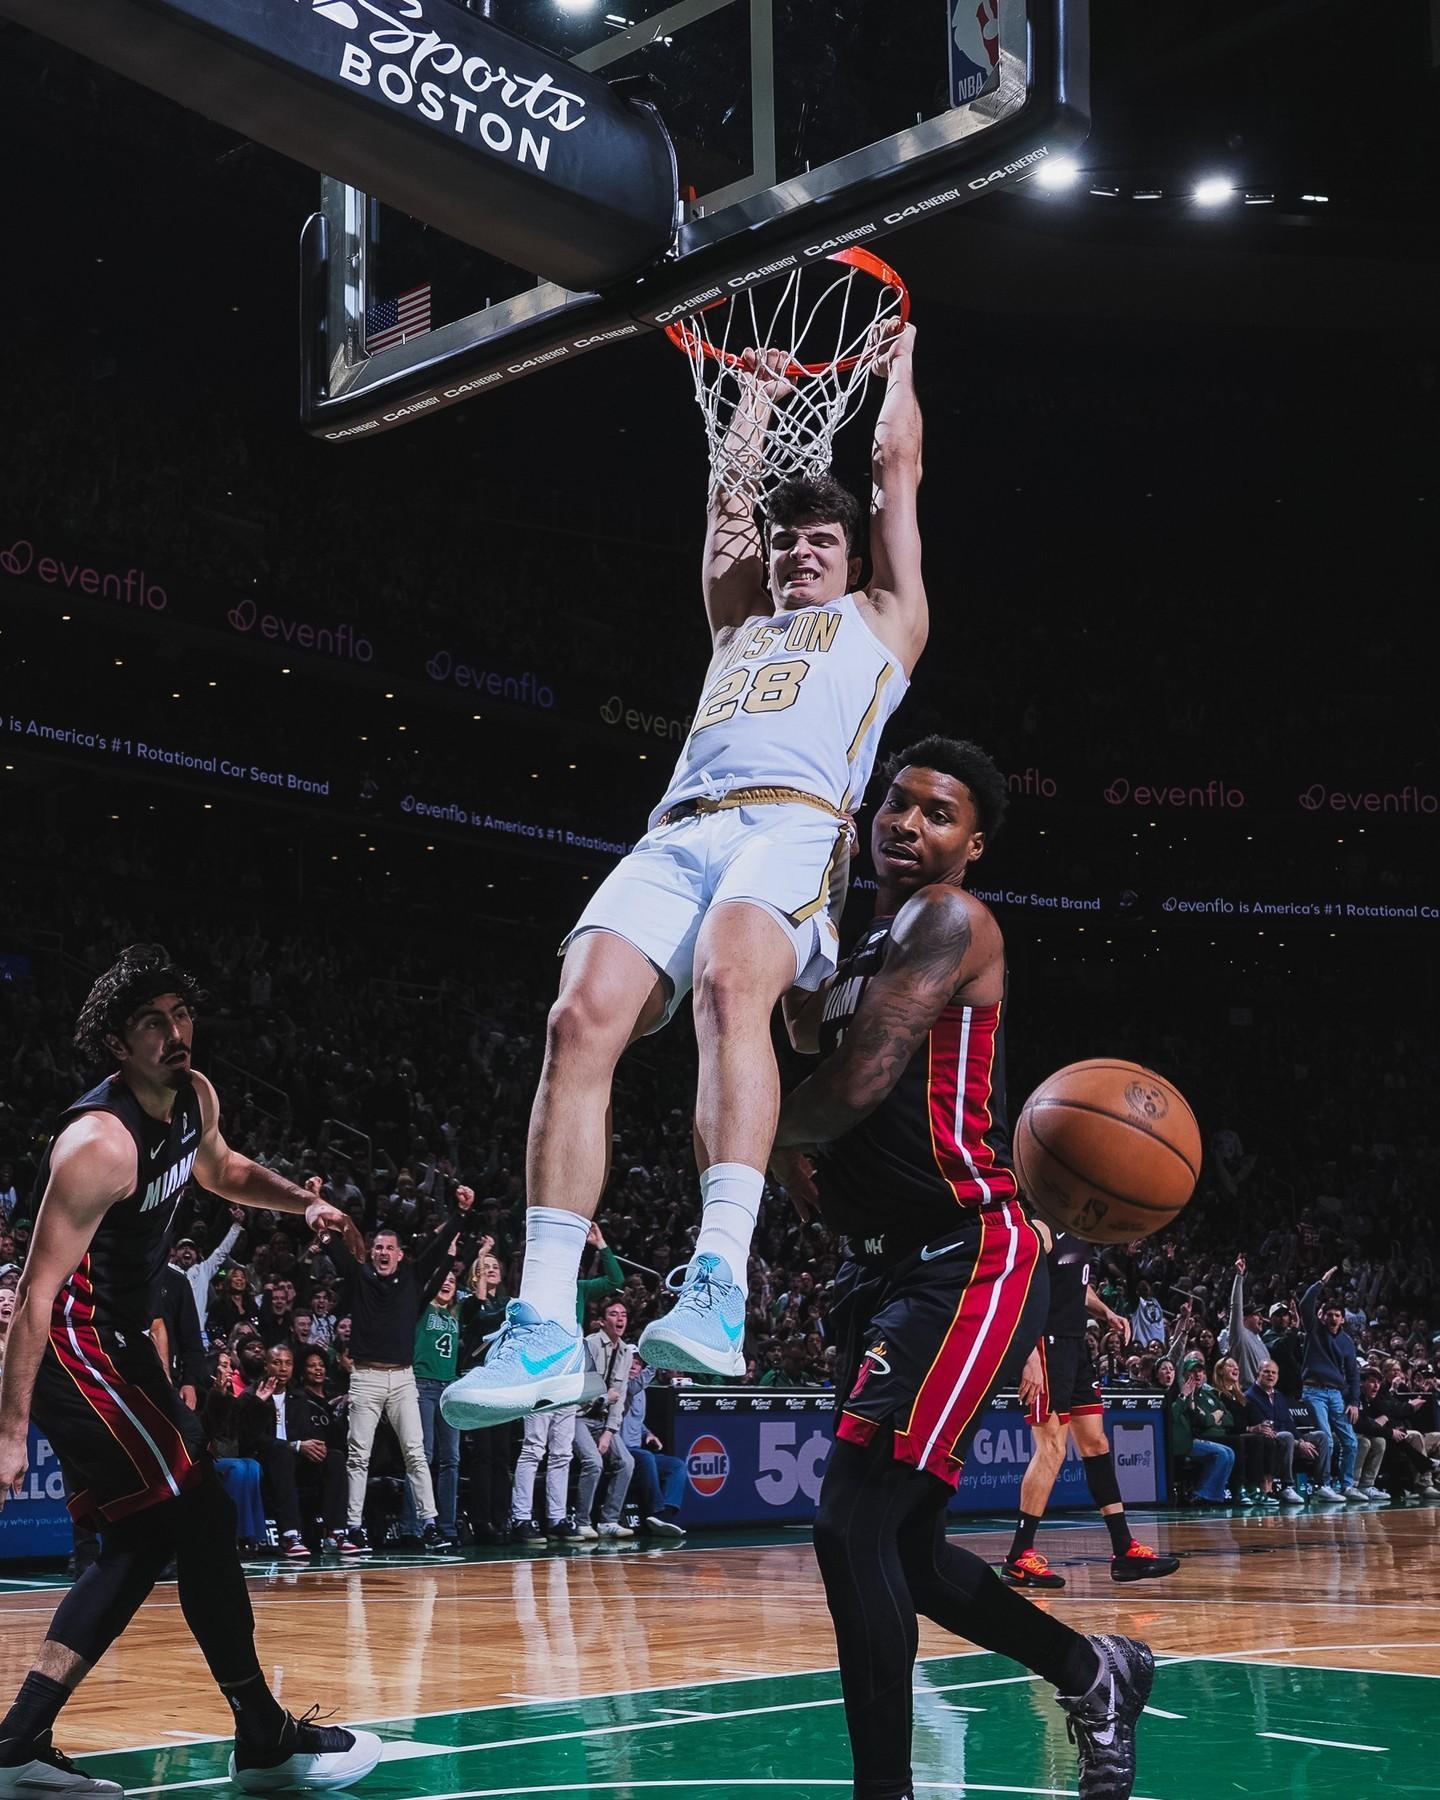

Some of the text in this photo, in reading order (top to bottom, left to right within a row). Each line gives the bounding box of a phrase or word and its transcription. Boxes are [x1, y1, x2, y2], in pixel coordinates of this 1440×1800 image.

[356, 0, 586, 131] Sports
[958, 72, 983, 102] NBA
[339, 42, 550, 171] BOSTON
[968, 146, 1049, 191] C4 ENERGY
[883, 188, 960, 225] C4 ENERGY
[803, 223, 877, 257] C4 ENERGY
[727, 255, 798, 287] C4 ENERGY
[655, 287, 722, 323] C4 ENERGY
[574, 324, 638, 348] C4 ENERGY
[507, 347, 569, 374] C4 ENERGY
[444, 372, 503, 399] C4 ENERGY
[383, 396, 440, 422] C4 ENERGY
[325, 421, 380, 440] C4 ENERGY
[38, 558, 167, 610] evenflo
[261, 614, 374, 661] evenflo
[454, 664, 554, 708] evenflo
[690, 659, 810, 738] 28
[625, 709, 692, 741] evenf
[9, 716, 22, 731] is
[26, 720, 106, 750] America's
[137, 743, 217, 772] Rotational
[220, 760, 247, 779] Car
[251, 767, 284, 786] Seat
[287, 774, 329, 795] Brand
[1008, 768, 1056, 797] nflo
[1134, 781, 1244, 808] evenflo
[1330, 786, 1439, 813] evenflo
[415, 800, 467, 824] evenflo
[471, 812, 481, 826] is
[483, 816, 544, 839] America's
[566, 831, 629, 856] Rotational
[969, 888, 1100, 910] tional Car Seat Brand
[1178, 898, 1233, 914] evenflo
[1239, 900, 1249, 914] is
[1252, 901, 1320, 915] America's
[1347, 904, 1418, 918] Rotational
[1421, 905, 1440, 918] Ca
[139, 1147, 198, 1212] MIAMI
[435, 1333, 452, 1358] 4
[688, 1455, 728, 1475] Gulf
[980, 1472, 998, 1489] day
[1063, 1469, 1082, 1482] Gulf
